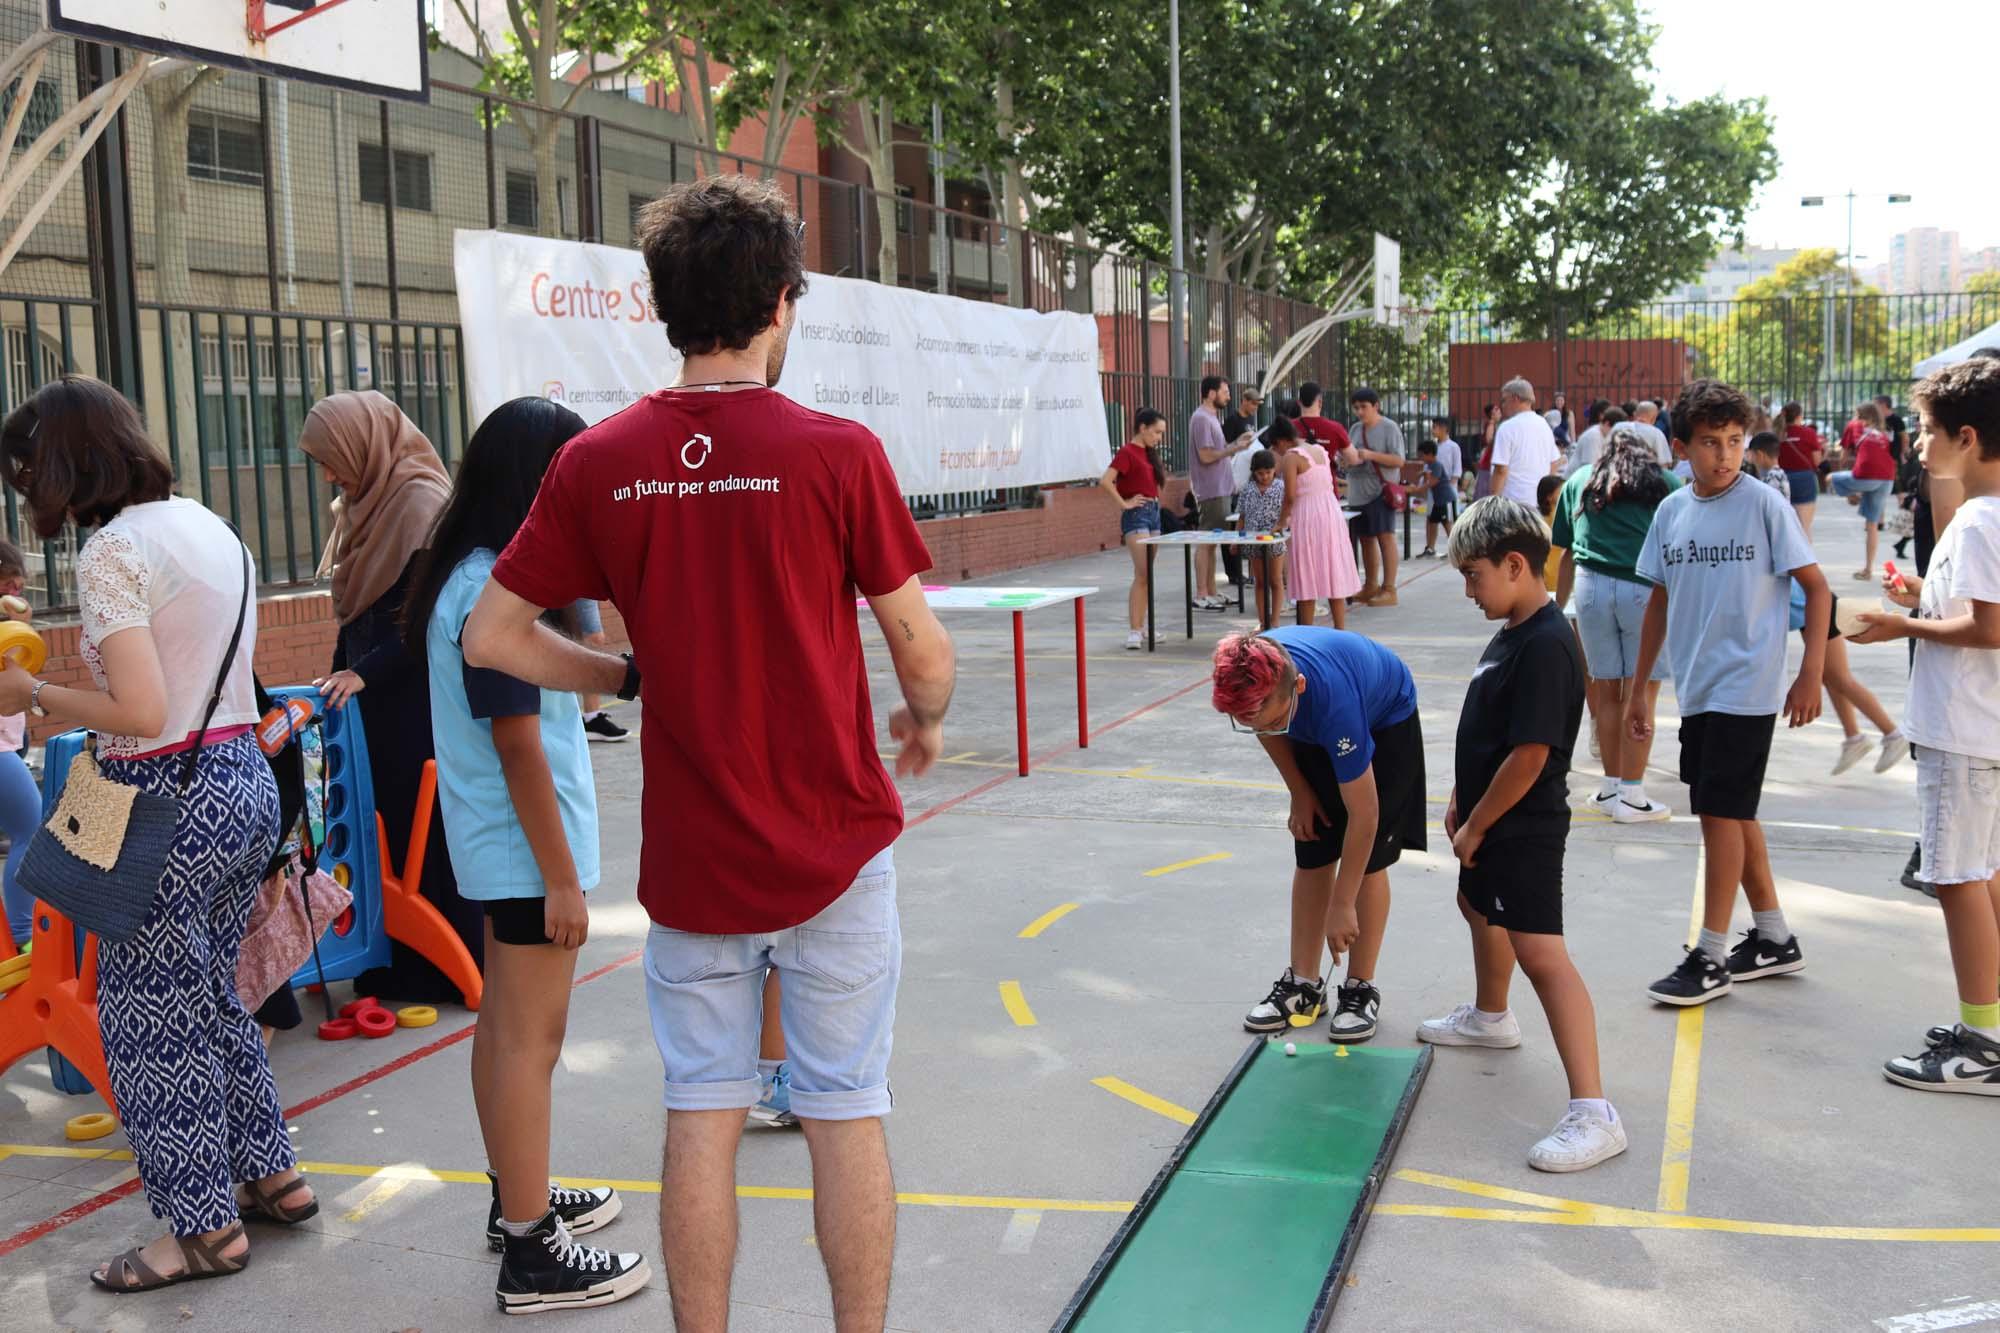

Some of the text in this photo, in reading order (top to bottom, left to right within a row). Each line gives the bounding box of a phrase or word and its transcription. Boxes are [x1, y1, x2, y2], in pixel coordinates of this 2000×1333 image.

[531, 271, 622, 321] Centre
[862, 386, 873, 405] el
[613, 475, 780, 501] un futur per endavant
[1687, 538, 1755, 568] Angeles
